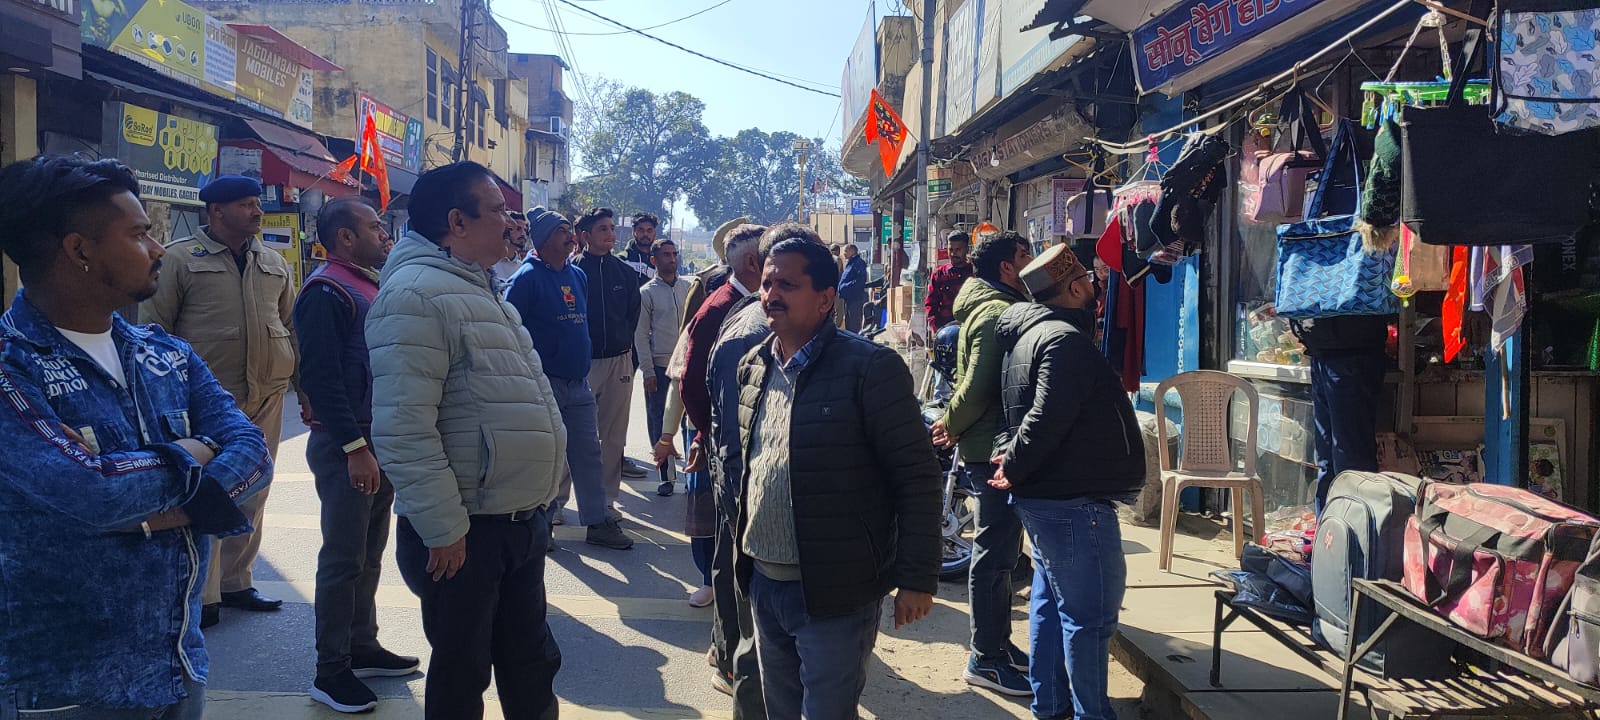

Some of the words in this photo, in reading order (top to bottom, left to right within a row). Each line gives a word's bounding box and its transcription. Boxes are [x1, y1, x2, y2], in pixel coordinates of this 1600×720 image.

[1144, 26, 1202, 71] सोनू
[1192, 1, 1231, 45] बैग
[241, 39, 298, 79] JAGDAMBAY
[245, 57, 287, 88] MOBILES
[159, 172, 187, 185] Distributor
[52, 436, 86, 462] FASHION
